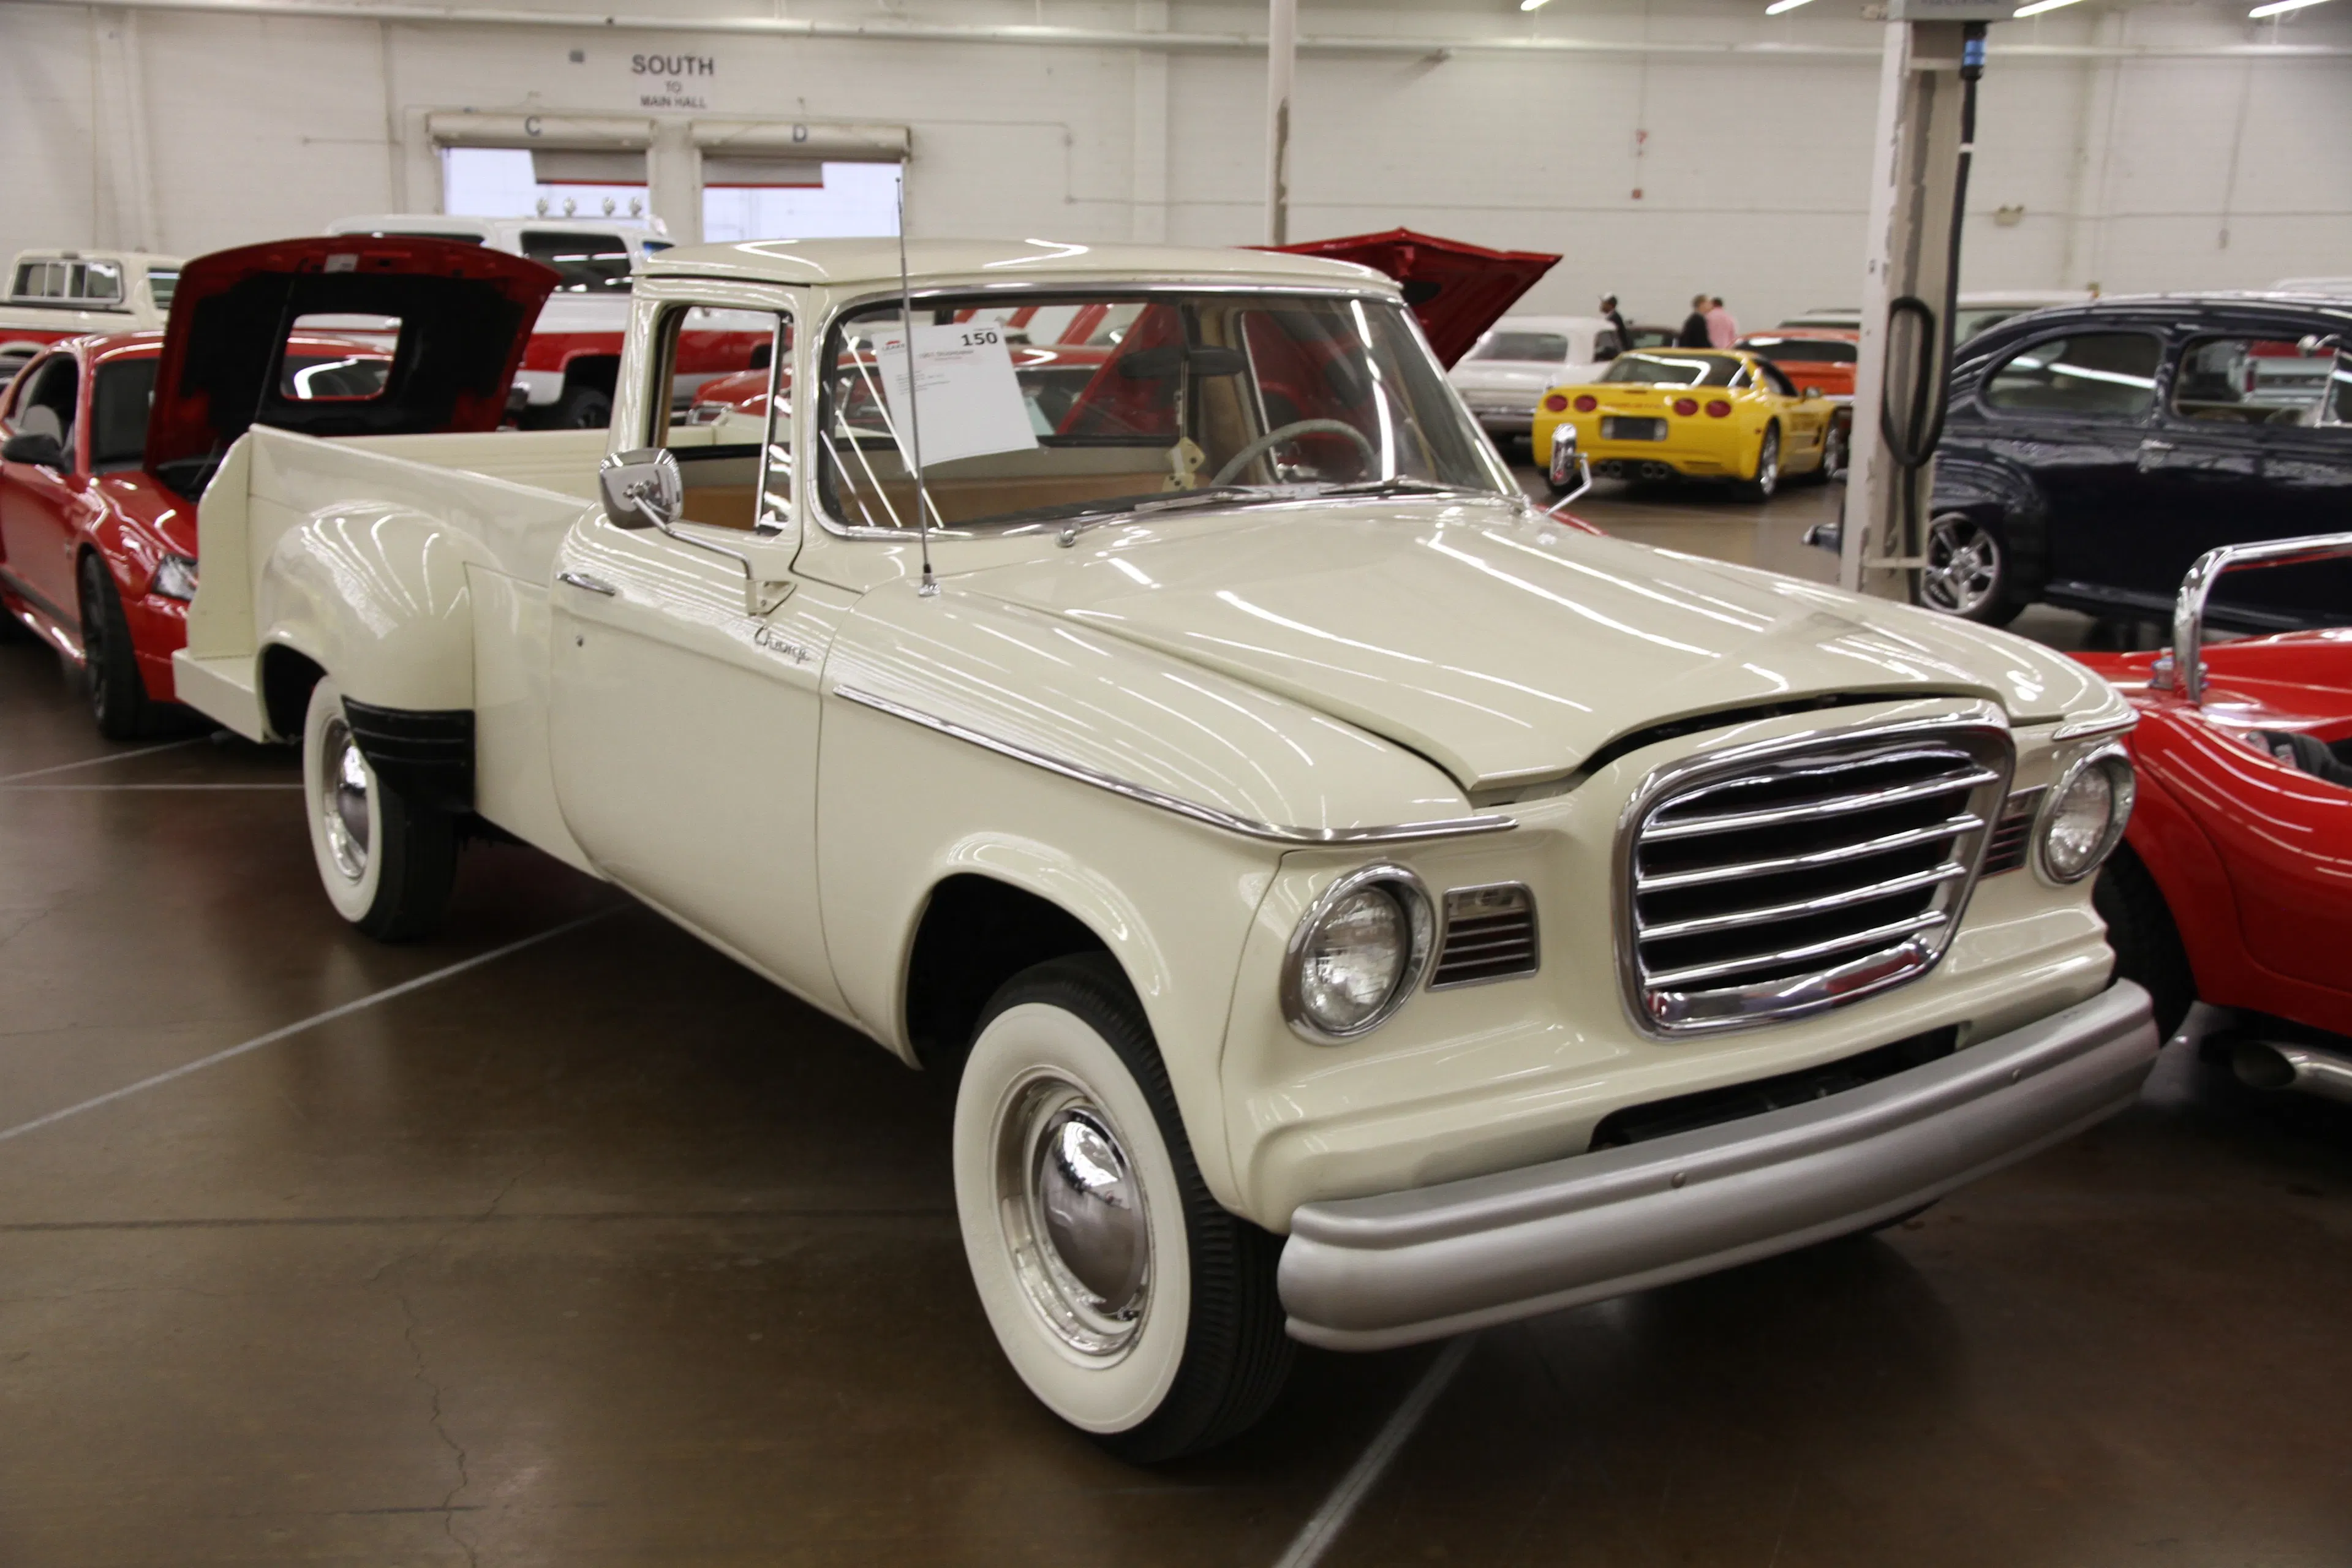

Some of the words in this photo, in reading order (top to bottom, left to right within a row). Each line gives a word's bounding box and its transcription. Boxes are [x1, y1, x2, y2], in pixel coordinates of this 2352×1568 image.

[631, 54, 714, 76] SOUTH
[665, 80, 683, 94] TO
[641, 96, 671, 107] MAIN
[674, 96, 706, 109] HALL
[525, 115, 541, 137] C
[793, 123, 808, 143] D
[961, 331, 998, 347] 150
